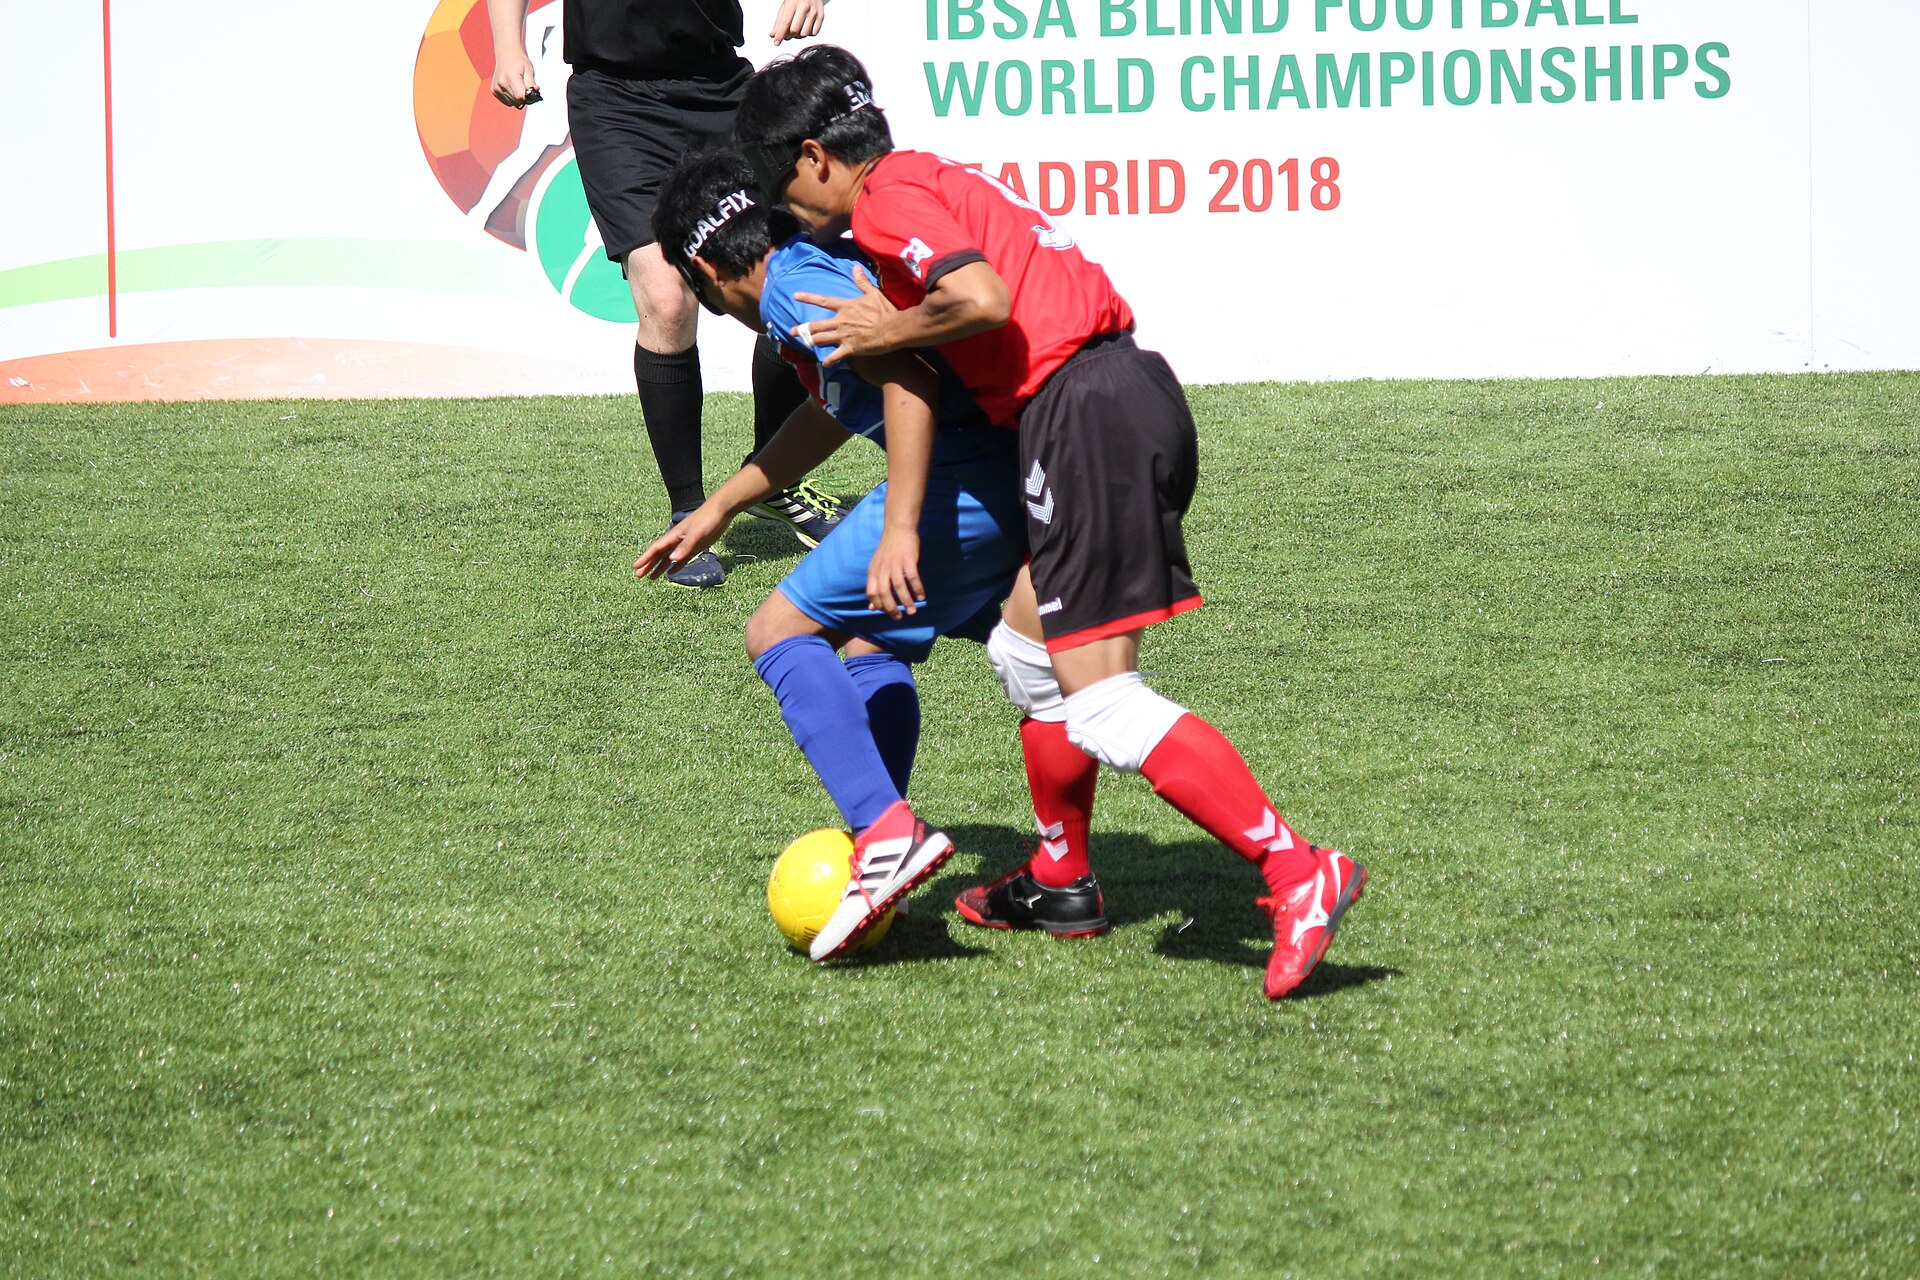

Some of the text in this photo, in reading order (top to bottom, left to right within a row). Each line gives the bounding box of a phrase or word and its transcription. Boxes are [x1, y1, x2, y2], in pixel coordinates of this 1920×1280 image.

[926, 0, 1077, 41] IBSA
[1100, 0, 1290, 37] BLIND
[922, 58, 1155, 118] WORLD
[1179, 42, 1731, 113] CHAMPIONSHIPS
[964, 156, 1341, 217] ADRID 2018
[683, 189, 756, 258] GOALFIX
